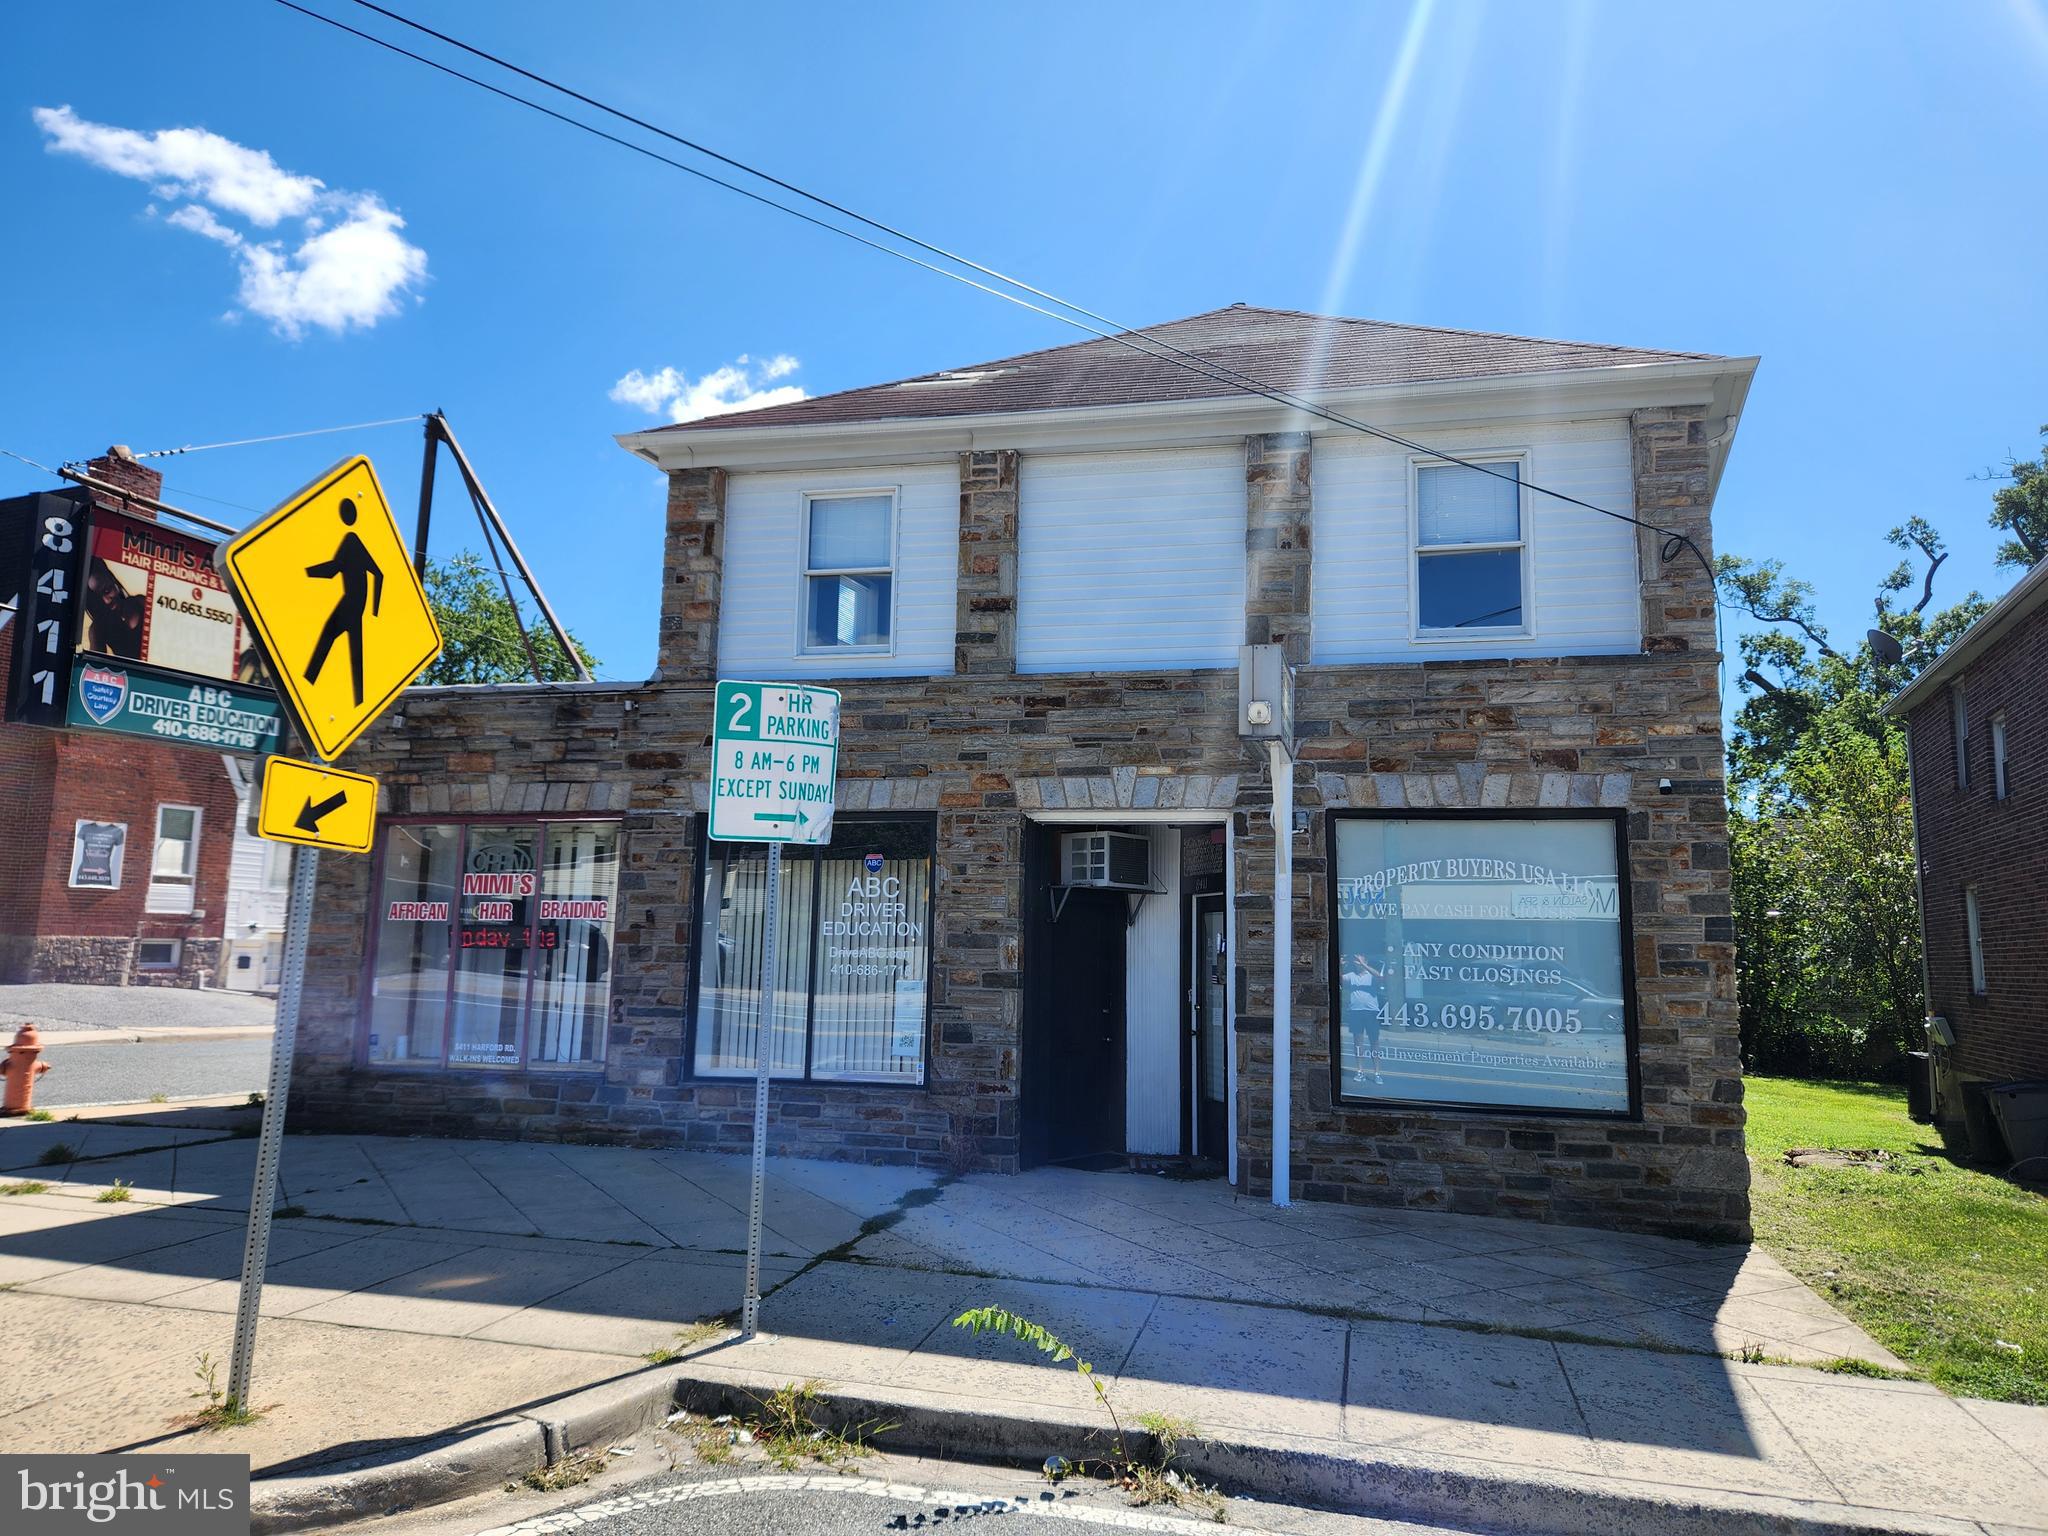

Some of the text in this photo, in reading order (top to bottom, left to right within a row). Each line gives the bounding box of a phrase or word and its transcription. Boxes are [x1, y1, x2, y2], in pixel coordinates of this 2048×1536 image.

[122, 526, 218, 576] Mimi's A
[121, 551, 151, 569] HAIR
[153, 559, 209, 587] BRAIDING
[209, 577, 220, 589] &
[32, 516, 73, 705] 8411
[156, 595, 233, 626] 410.663.5550
[94, 673, 117, 684] ABC
[92, 685, 113, 696] Safety
[188, 685, 232, 708] ABC
[94, 702, 109, 710] Law
[133, 695, 275, 734] DRIVER EDUCATION
[728, 693, 753, 732] 2
[788, 693, 812, 714] HR
[152, 719, 256, 748] 410-686-1718
[767, 716, 829, 740] PARKING
[735, 751, 743, 769] 8
[802, 755, 820, 774] PM
[717, 778, 829, 803] EXCEPT SUNDAY
[867, 859, 882, 867] ABC
[463, 873, 536, 896] MIMI'S
[847, 877, 900, 898] ABC
[1354, 860, 1442, 896] PROPERTY
[1446, 858, 1516, 880] BUYERS
[1520, 864, 1559, 888] USA
[388, 900, 608, 921] AFRICAN HAIR BRAIDING
[841, 903, 906, 917] DRIVER
[1374, 903, 1397, 916] WE
[1402, 904, 1431, 917] PAY
[1434, 904, 1473, 917] CASH
[1479, 904, 1510, 918] FOR
[823, 922, 922, 936] EDUCATION
[829, 947, 914, 959] DriveABC.com
[1403, 943, 1564, 960] ANY CONDITION
[830, 964, 912, 976] 410-686-1718
[1404, 965, 1561, 984] FAST CLOSINGS
[1376, 1002, 1582, 1033] 443.695.7005
[471, 1044, 503, 1052] HARFORD
[1356, 1045, 1606, 1069] Local Investment Properties Available
